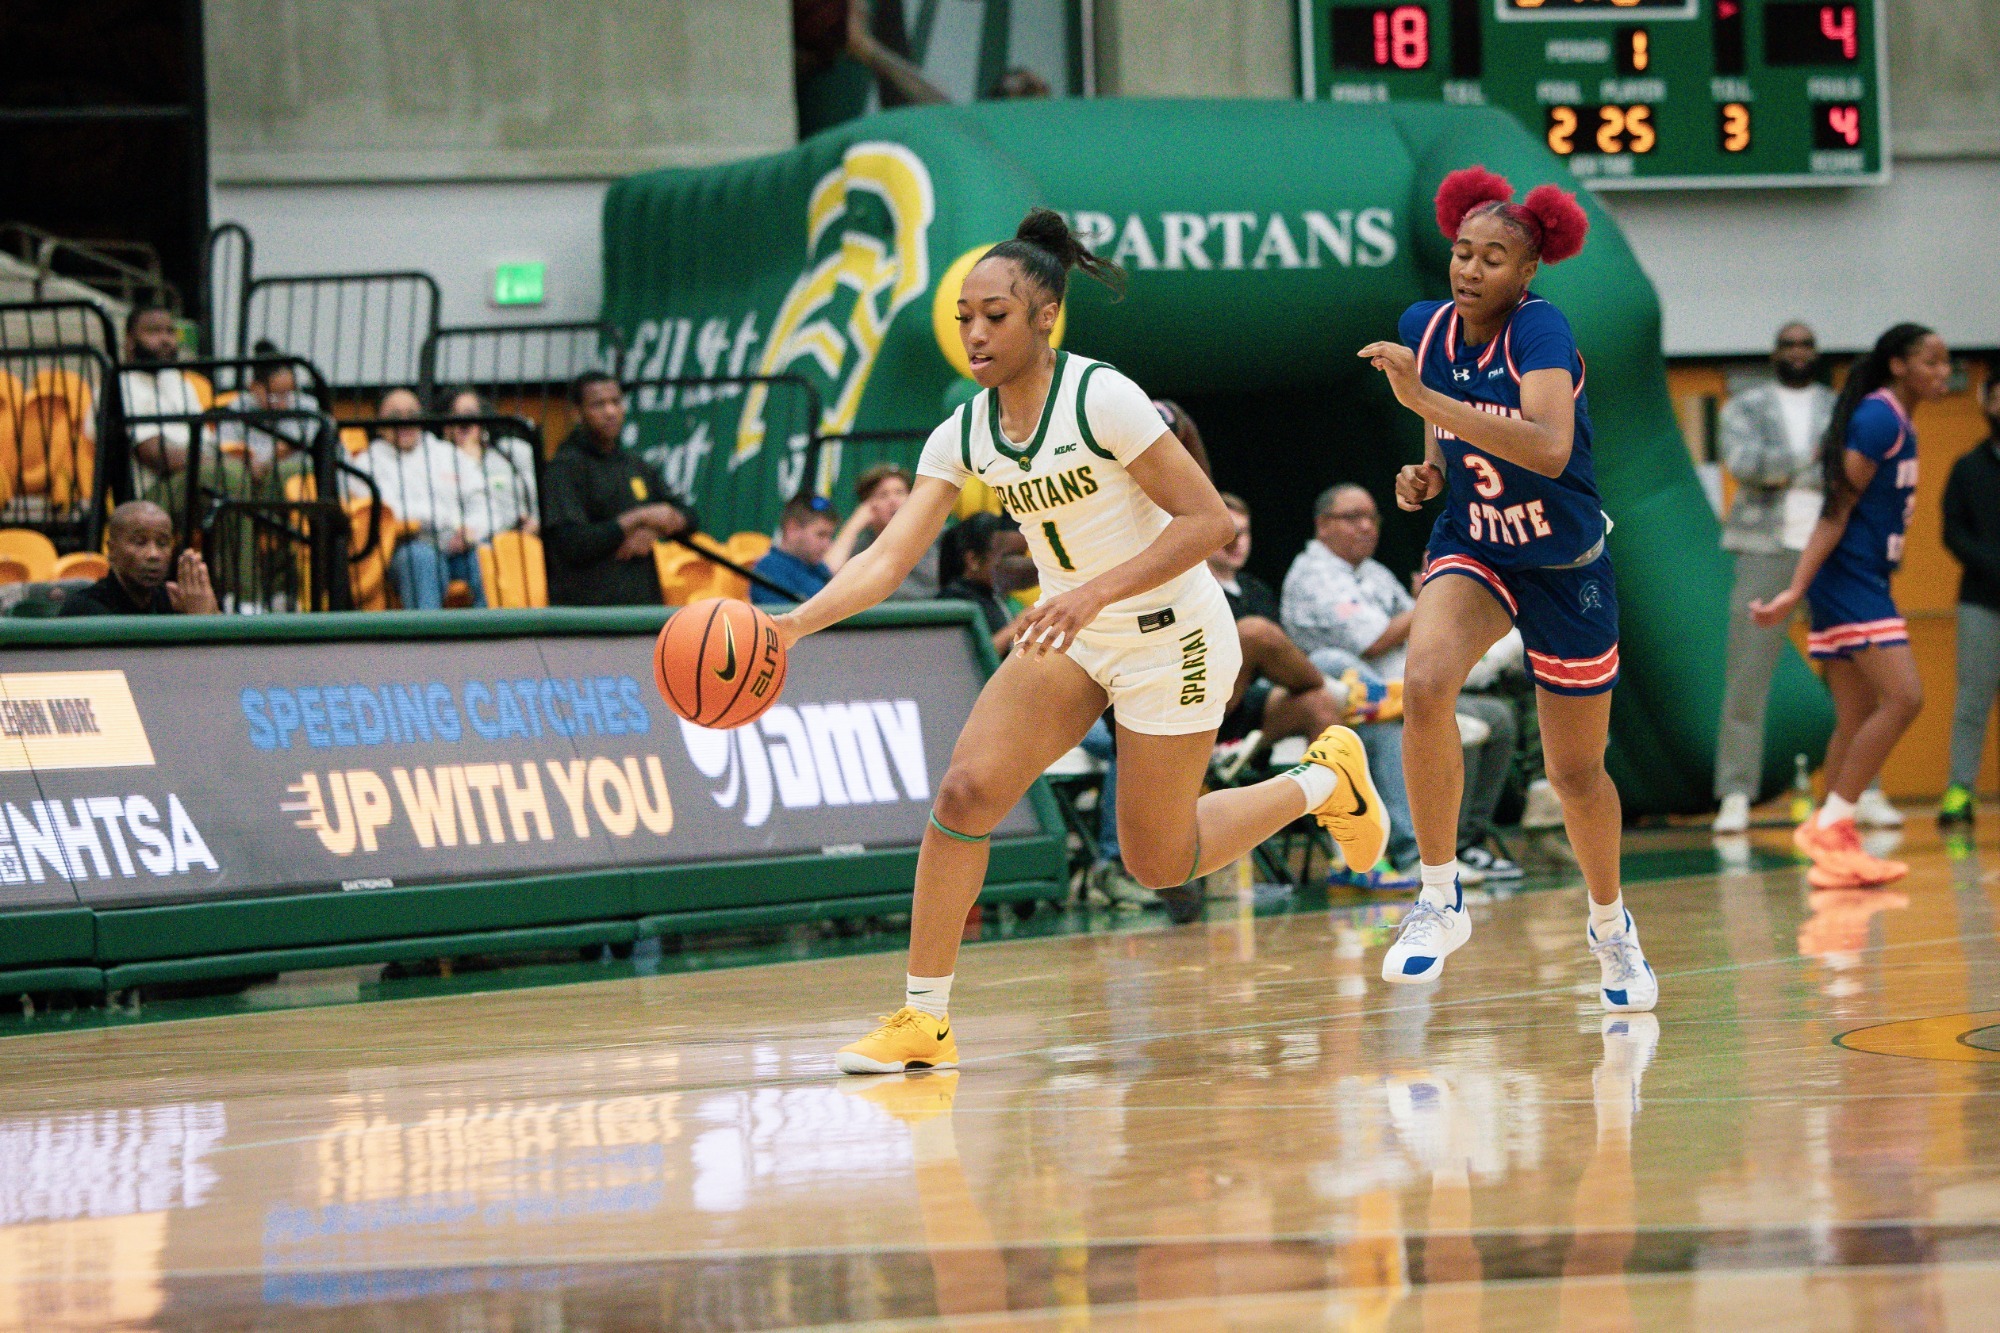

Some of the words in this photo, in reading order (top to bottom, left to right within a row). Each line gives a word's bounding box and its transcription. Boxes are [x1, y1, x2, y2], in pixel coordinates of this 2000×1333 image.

[1373, 4, 1429, 70] 18
[1631, 30, 1649, 71] 1
[1819, 5, 1858, 60] 4
[1548, 105, 1578, 155] 2
[1596, 104, 1656, 154] 25
[1722, 102, 1750, 152] 3
[1828, 105, 1860, 146] 4
[1064, 208, 1398, 271] PARTANS
[991, 465, 1100, 515] PARTANS
[1463, 453, 1504, 500] 3
[1041, 519, 1077, 573] 1
[1468, 499, 1553, 547] STATE
[750, 626, 779, 698] ELITE
[240, 683, 462, 751] SPEEDING
[463, 675, 651, 741] CATCHES
[300, 768, 393, 857] UP
[392, 760, 555, 848] WITH
[546, 755, 674, 838] YOU
[6, 793, 219, 884] NHTSA
